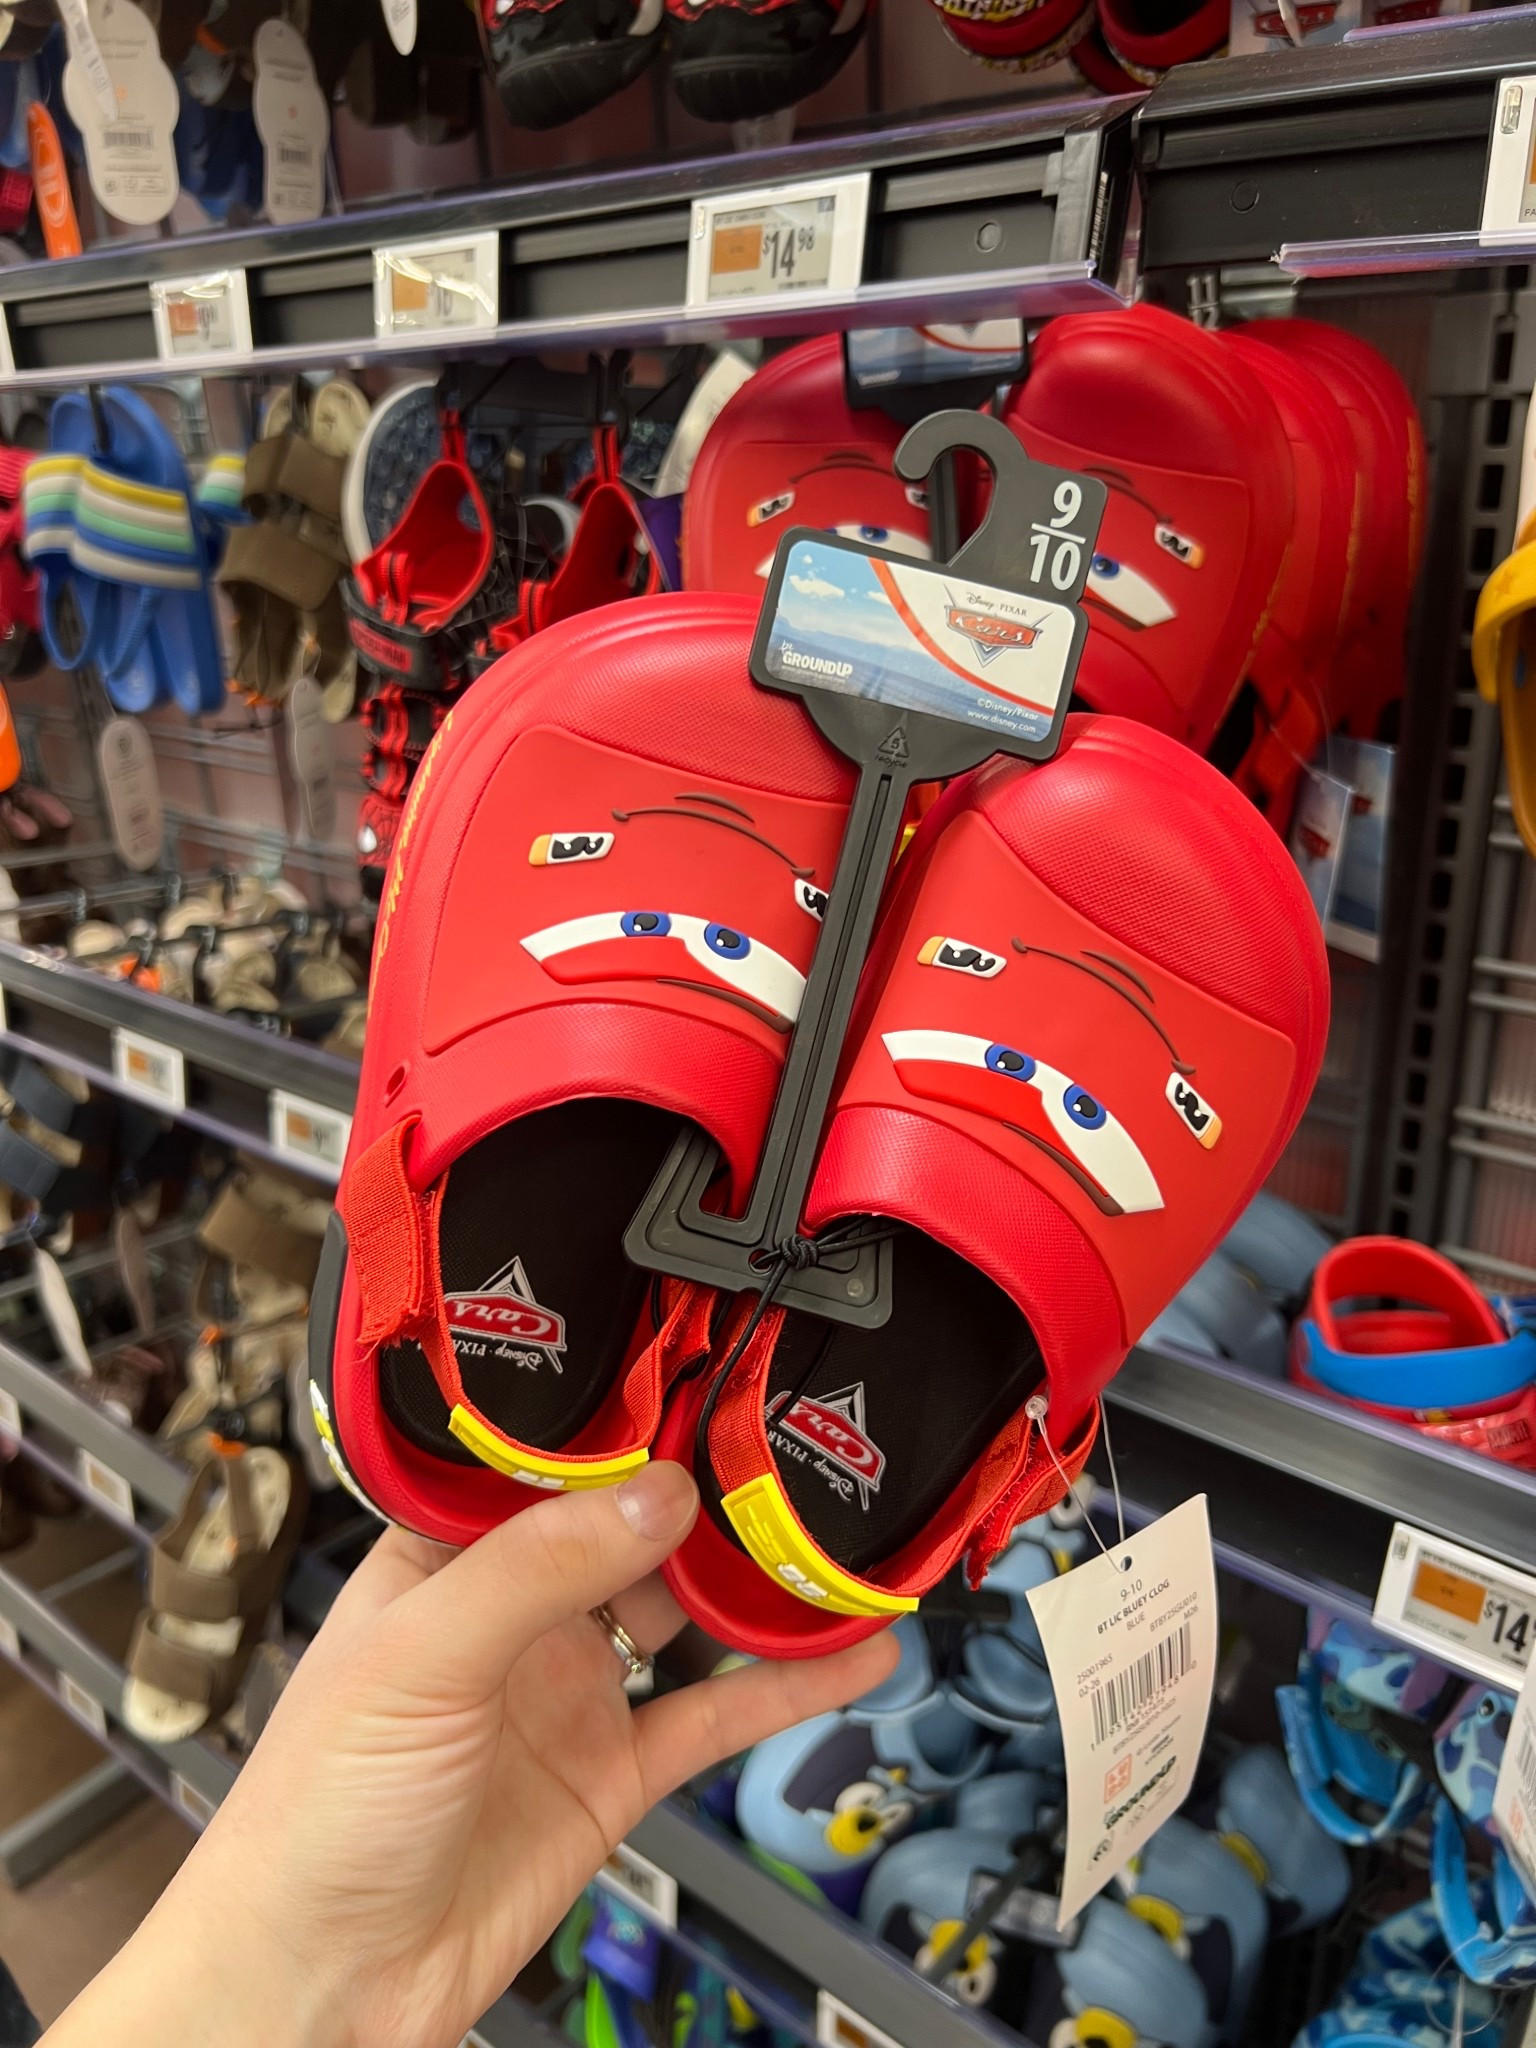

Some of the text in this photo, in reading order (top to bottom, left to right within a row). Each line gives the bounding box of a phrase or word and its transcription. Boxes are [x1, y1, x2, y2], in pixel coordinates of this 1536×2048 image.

[1050, 480, 1082, 529] 9
[1030, 533, 1081, 591] 10
[966, 591, 1028, 617] Disney PIXAR
[954, 614, 1025, 644] Cars
[967, 709, 1036, 733] www.disney.com
[451, 1300, 552, 1337] Cars
[453, 1339, 544, 1371] Disney PIXA
[767, 1429, 855, 1502] Disney PIXAR
[1097, 1578, 1170, 1635] BT LIC BLUEY CLOG
[1120, 1579, 1143, 1602] 9-10
[1126, 1611, 1146, 1631] BLUE
[1483, 1600, 1536, 1652] $14
